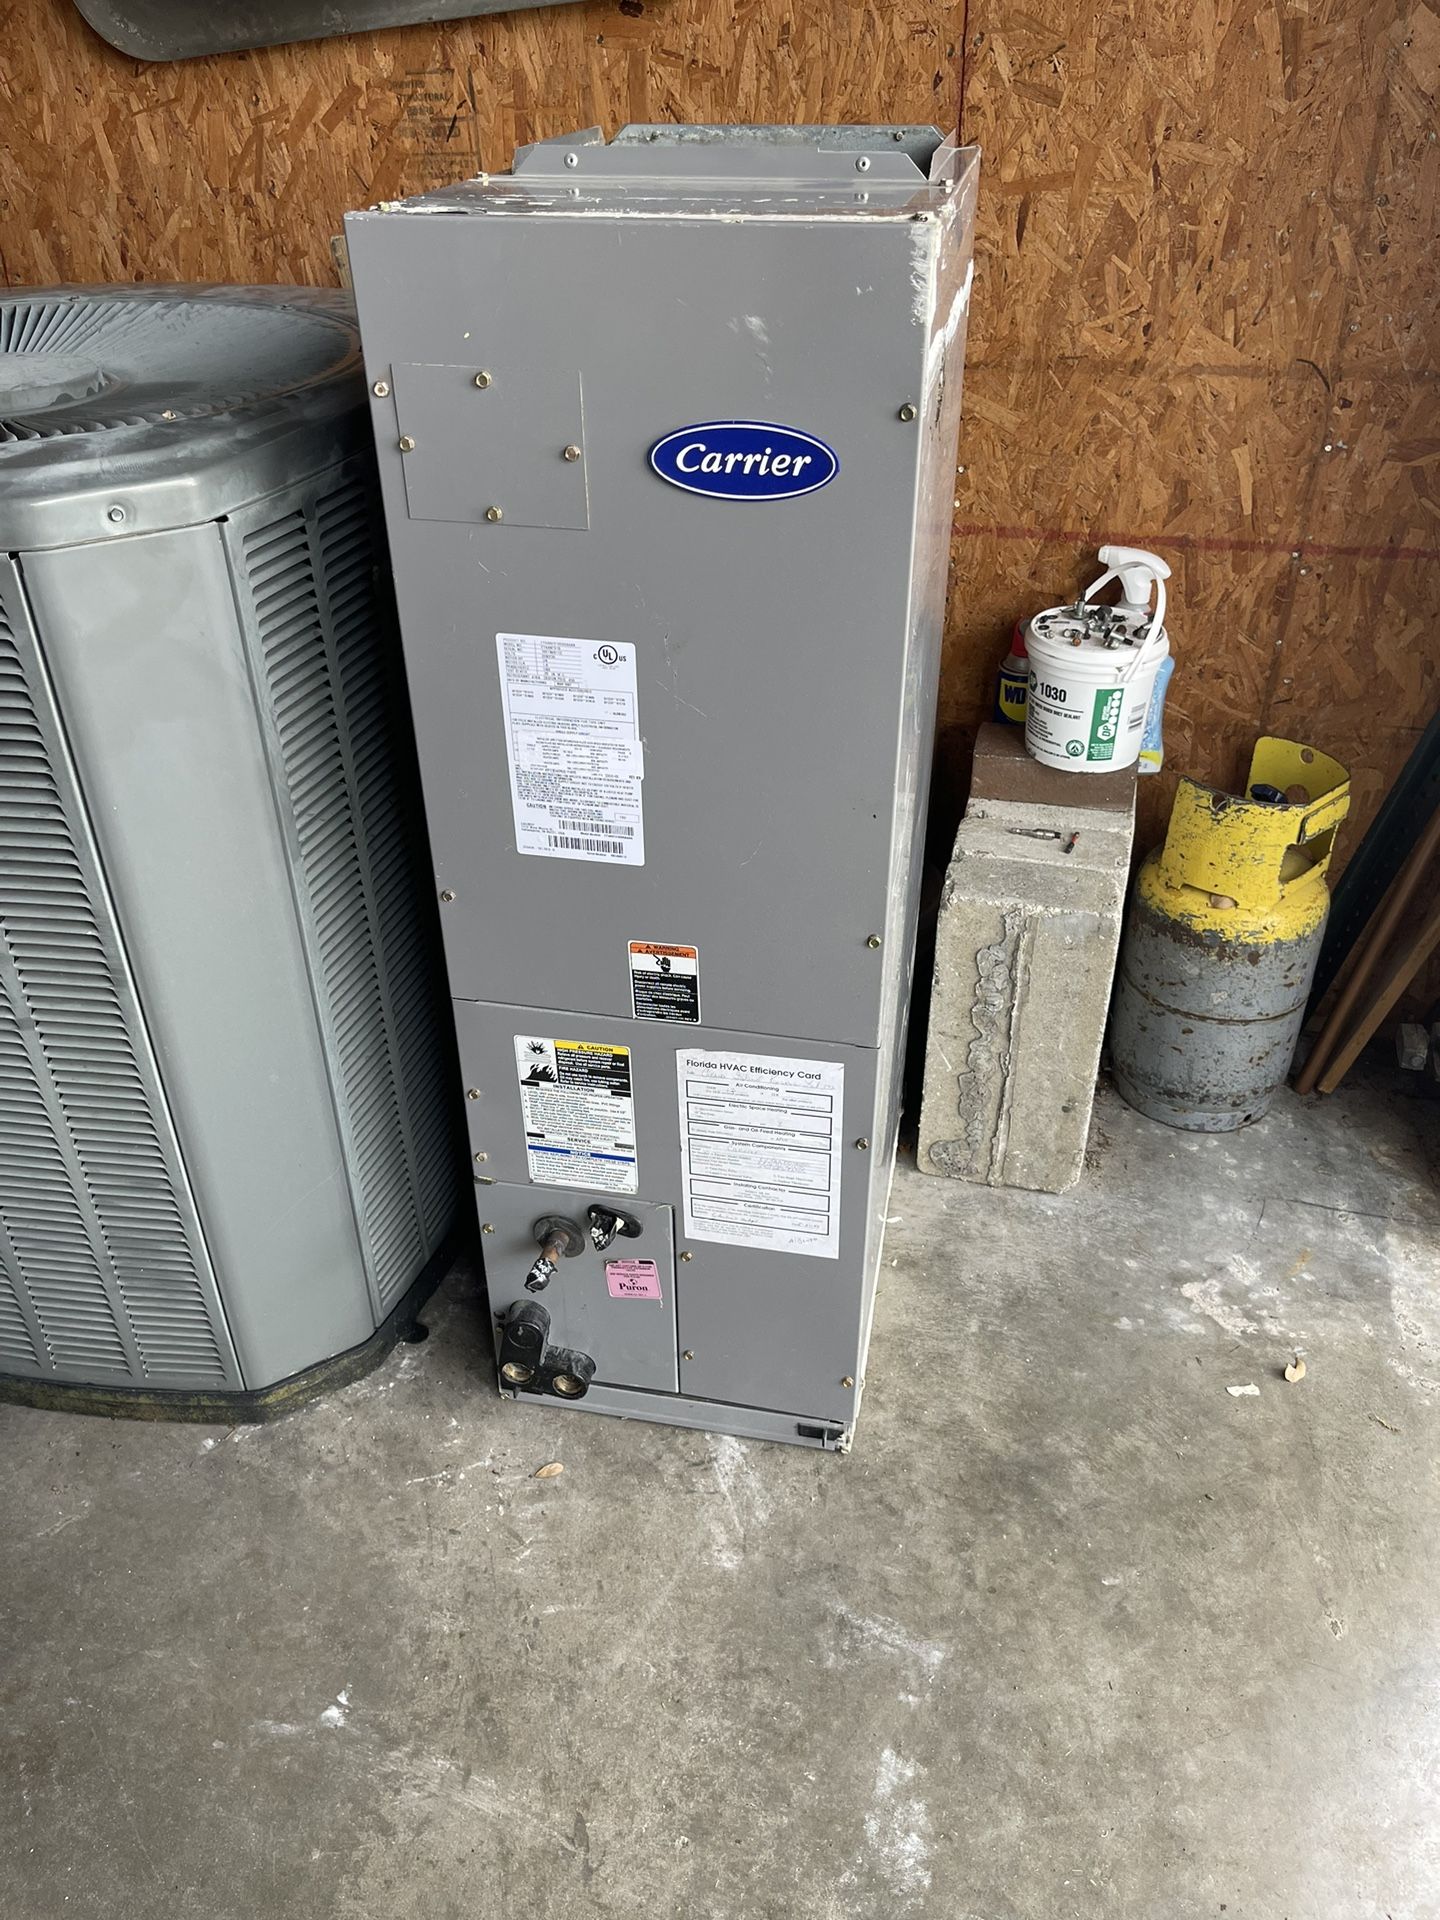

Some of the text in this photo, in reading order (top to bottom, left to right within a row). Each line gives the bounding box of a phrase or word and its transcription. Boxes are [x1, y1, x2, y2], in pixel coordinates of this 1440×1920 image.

[676, 443, 812, 477] Carrier
[602, 649, 613, 660] UL
[1040, 682, 1067, 703] 1030
[1102, 725, 1111, 737] DP
[686, 1059, 717, 1069] Florida
[720, 1063, 748, 1072] HVAC
[750, 1066, 795, 1078] Efficiency
[797, 1071, 822, 1080] Card
[553, 1084, 594, 1092] INSTALLATION
[744, 1083, 780, 1092] Conditioning
[774, 1129, 796, 1137] Heating
[752, 1143, 786, 1152] Components
[758, 1185, 786, 1193] Contractor
[619, 1283, 648, 1291] Puron
